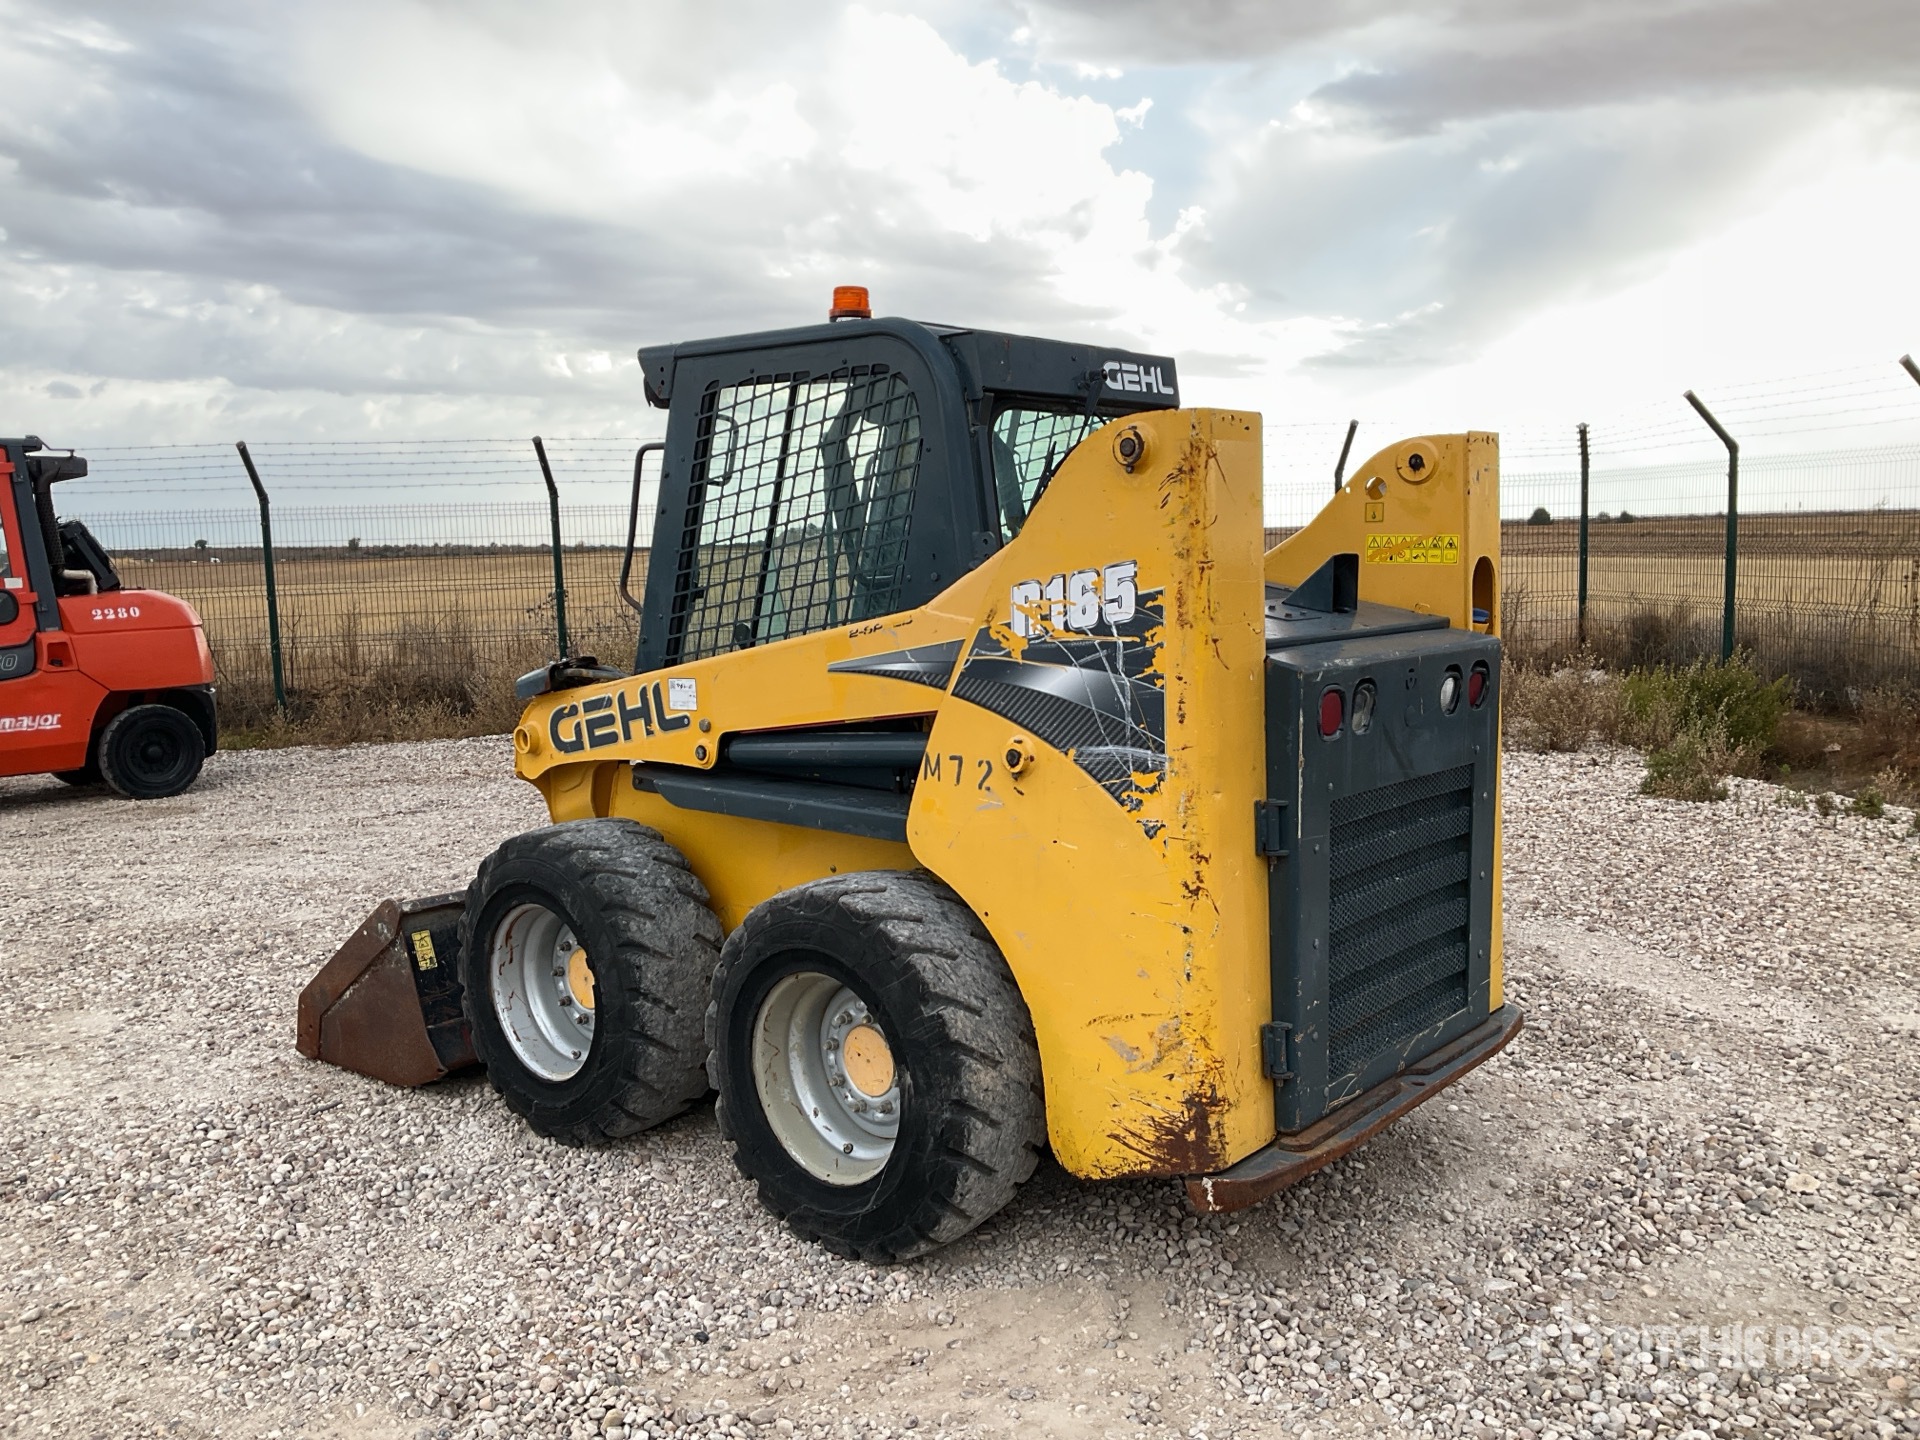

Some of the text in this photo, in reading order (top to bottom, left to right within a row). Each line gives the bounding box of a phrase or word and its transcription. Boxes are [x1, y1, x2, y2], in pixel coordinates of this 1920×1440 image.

[1103, 361, 1174, 395] GEHL
[91, 606, 140, 620] 2280
[1010, 559, 1138, 639] R165
[549, 680, 690, 754] GEHL
